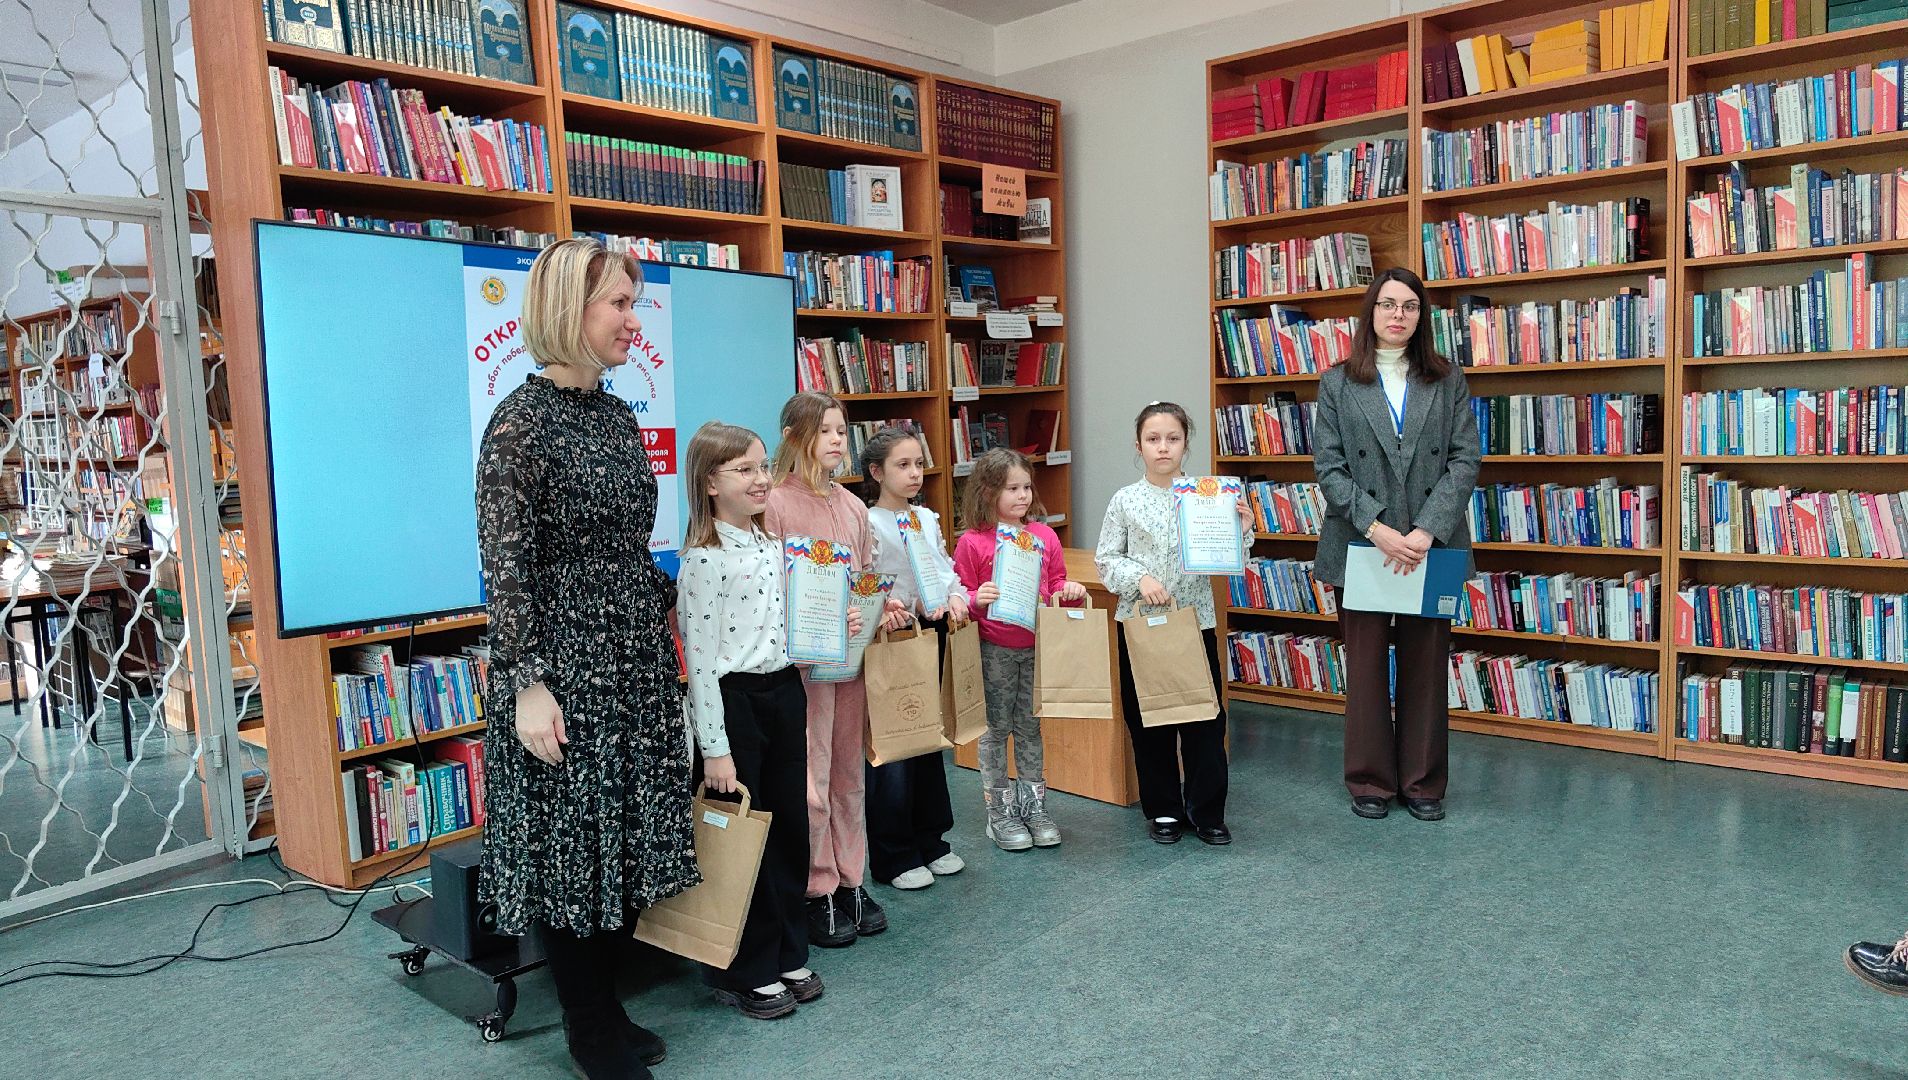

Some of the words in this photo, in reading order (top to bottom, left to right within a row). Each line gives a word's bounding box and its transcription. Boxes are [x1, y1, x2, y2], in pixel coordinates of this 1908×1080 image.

[474, 316, 523, 362] ОТКР
[631, 332, 664, 369] ВКИ
[487, 365, 502, 396] работ
[501, 345, 528, 366] побед
[629, 400, 648, 413] ИХ
[643, 431, 659, 446] 19
[646, 448, 669, 458] враля
[650, 460, 667, 473] 00
[647, 539, 670, 548] одный
[440, 777, 455, 831] Справочник
